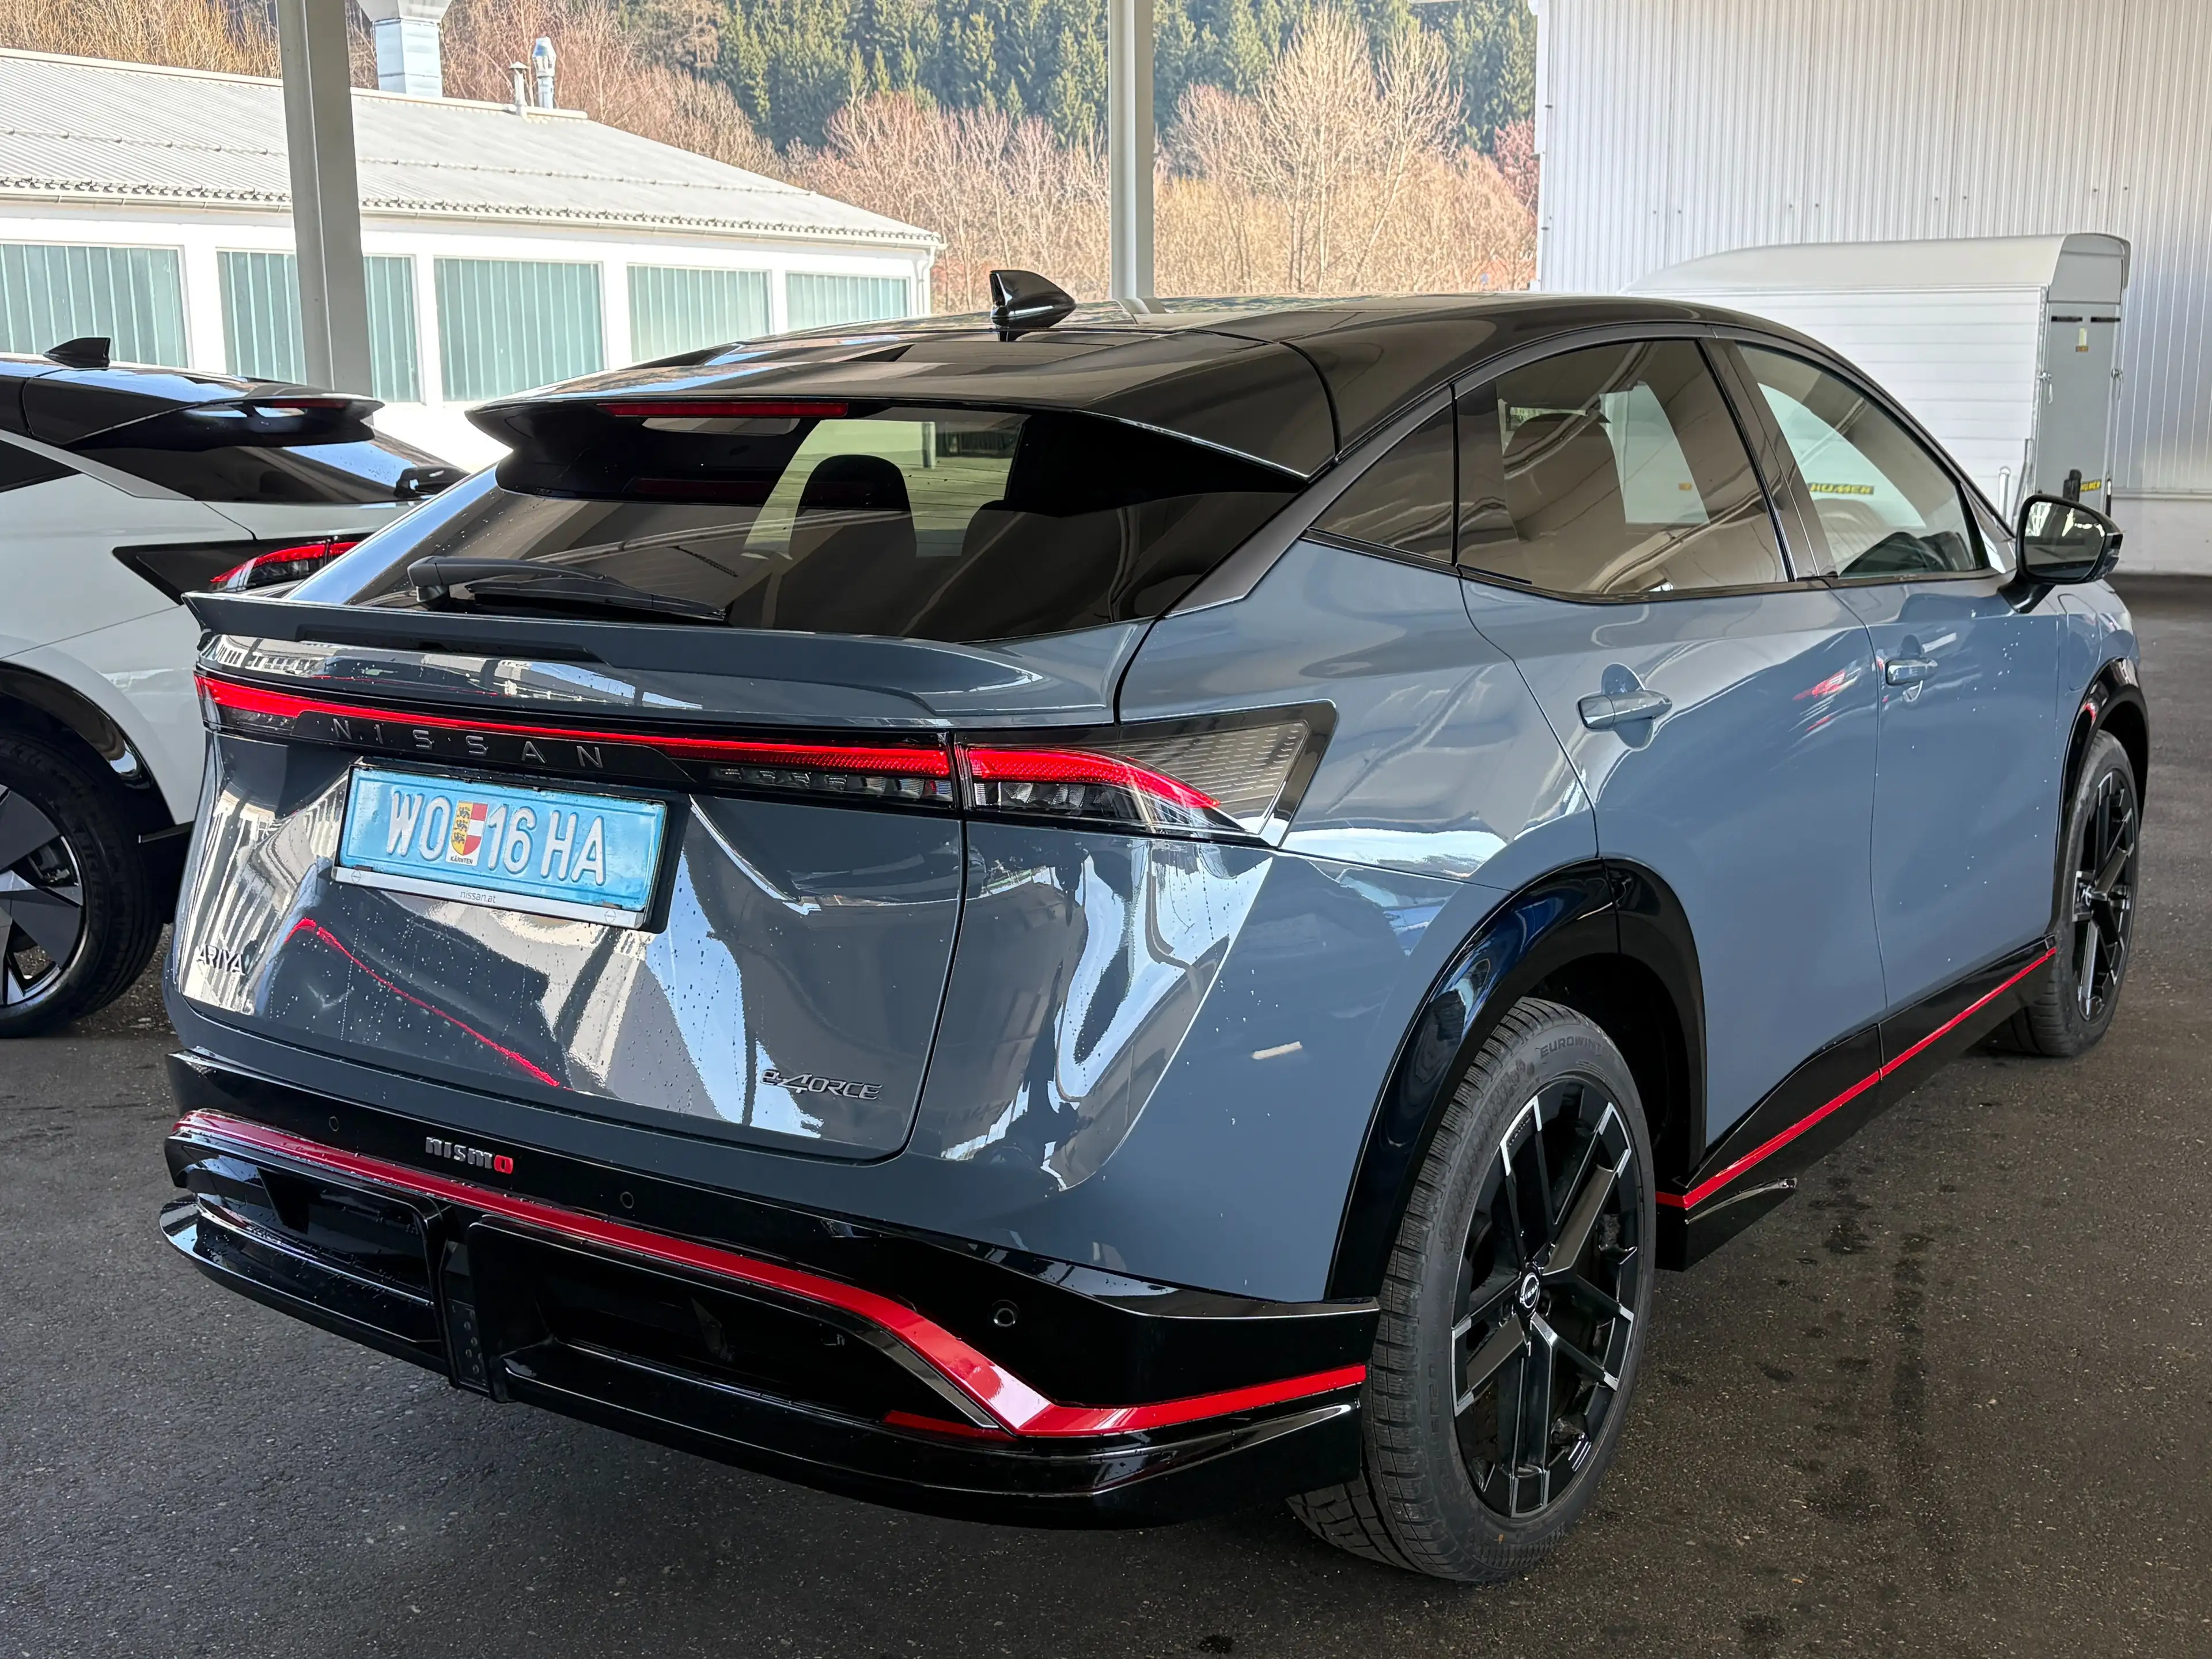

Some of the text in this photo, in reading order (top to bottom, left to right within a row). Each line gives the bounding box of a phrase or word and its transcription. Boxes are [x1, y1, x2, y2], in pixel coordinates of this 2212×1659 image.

[333, 718, 604, 769] NISSAN
[386, 790, 606, 886] WO 16 HA
[460, 891, 497, 904] nissan.at
[195, 945, 247, 976] ARIYA
